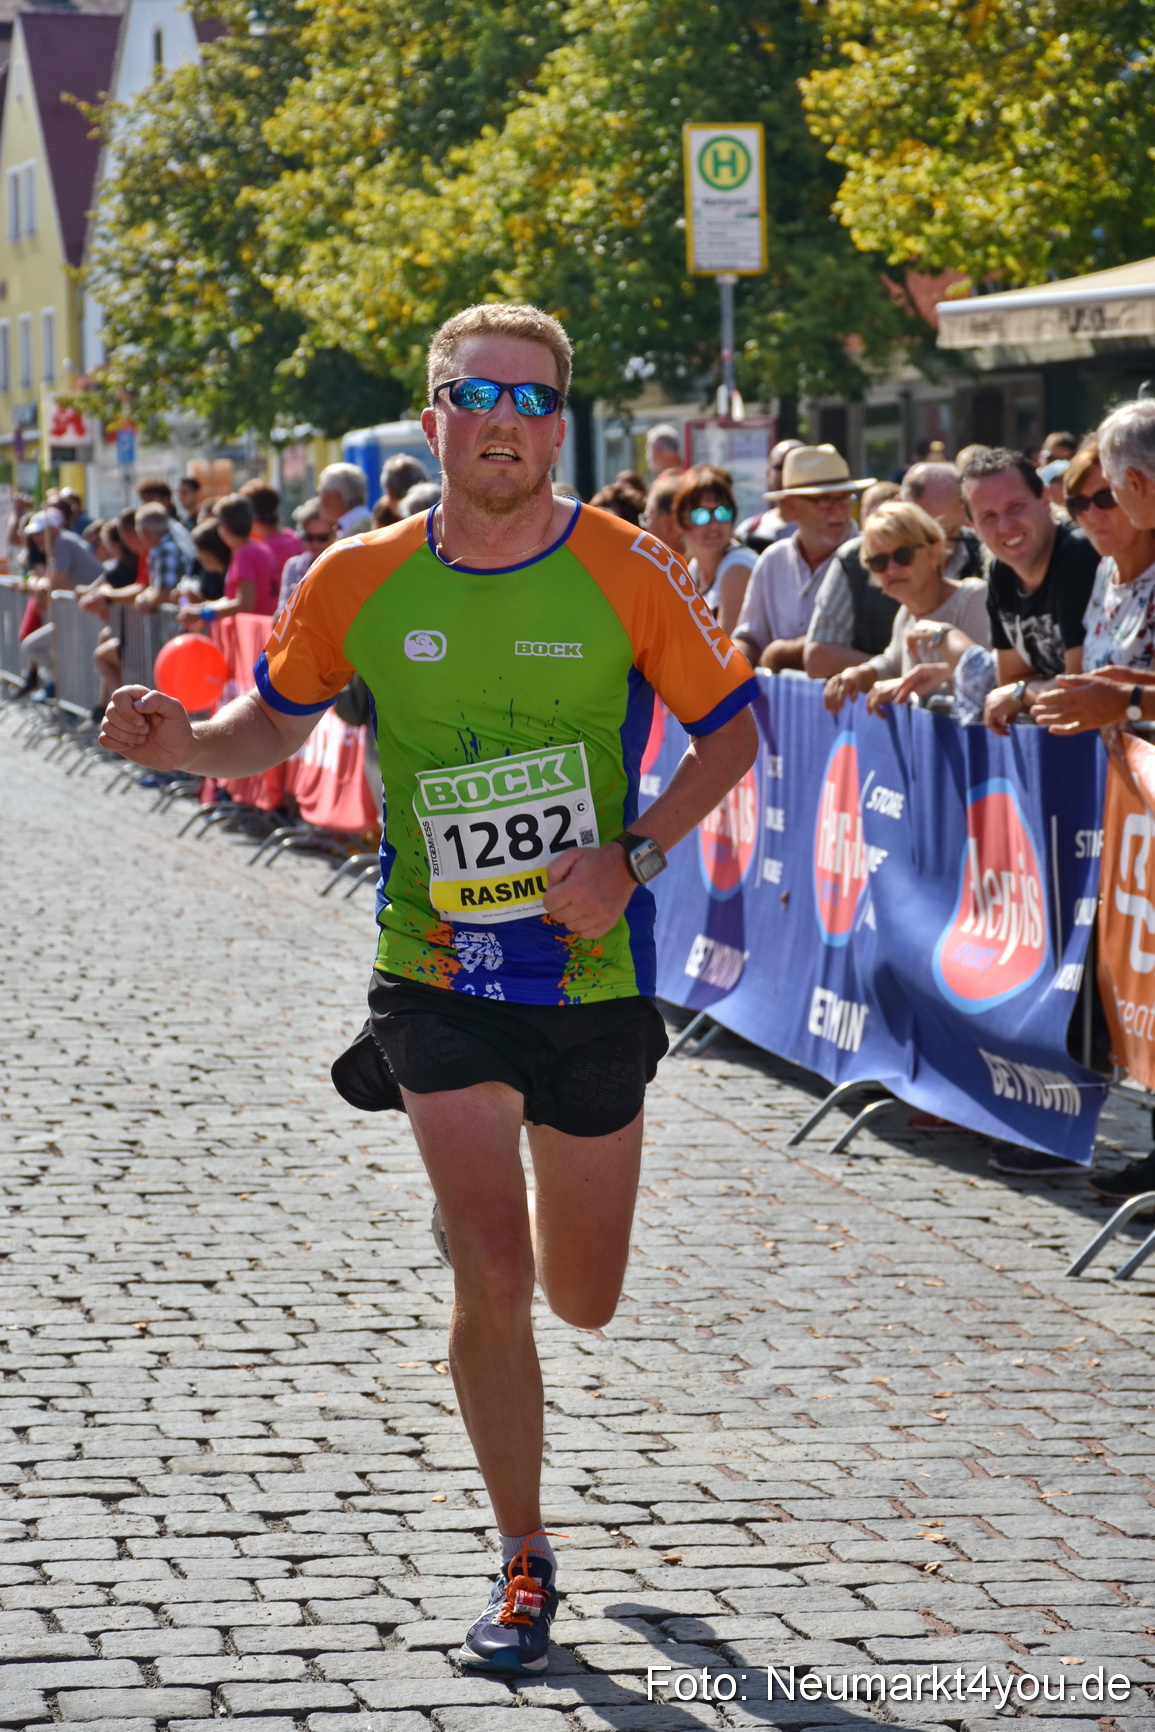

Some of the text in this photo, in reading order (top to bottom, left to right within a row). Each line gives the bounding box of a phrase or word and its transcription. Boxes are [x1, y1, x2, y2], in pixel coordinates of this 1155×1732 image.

[711, 148, 738, 179] H
[515, 641, 584, 658] BOCK
[421, 753, 574, 811] BOCK
[443, 805, 578, 869] 1282
[577, 803, 586, 812] C
